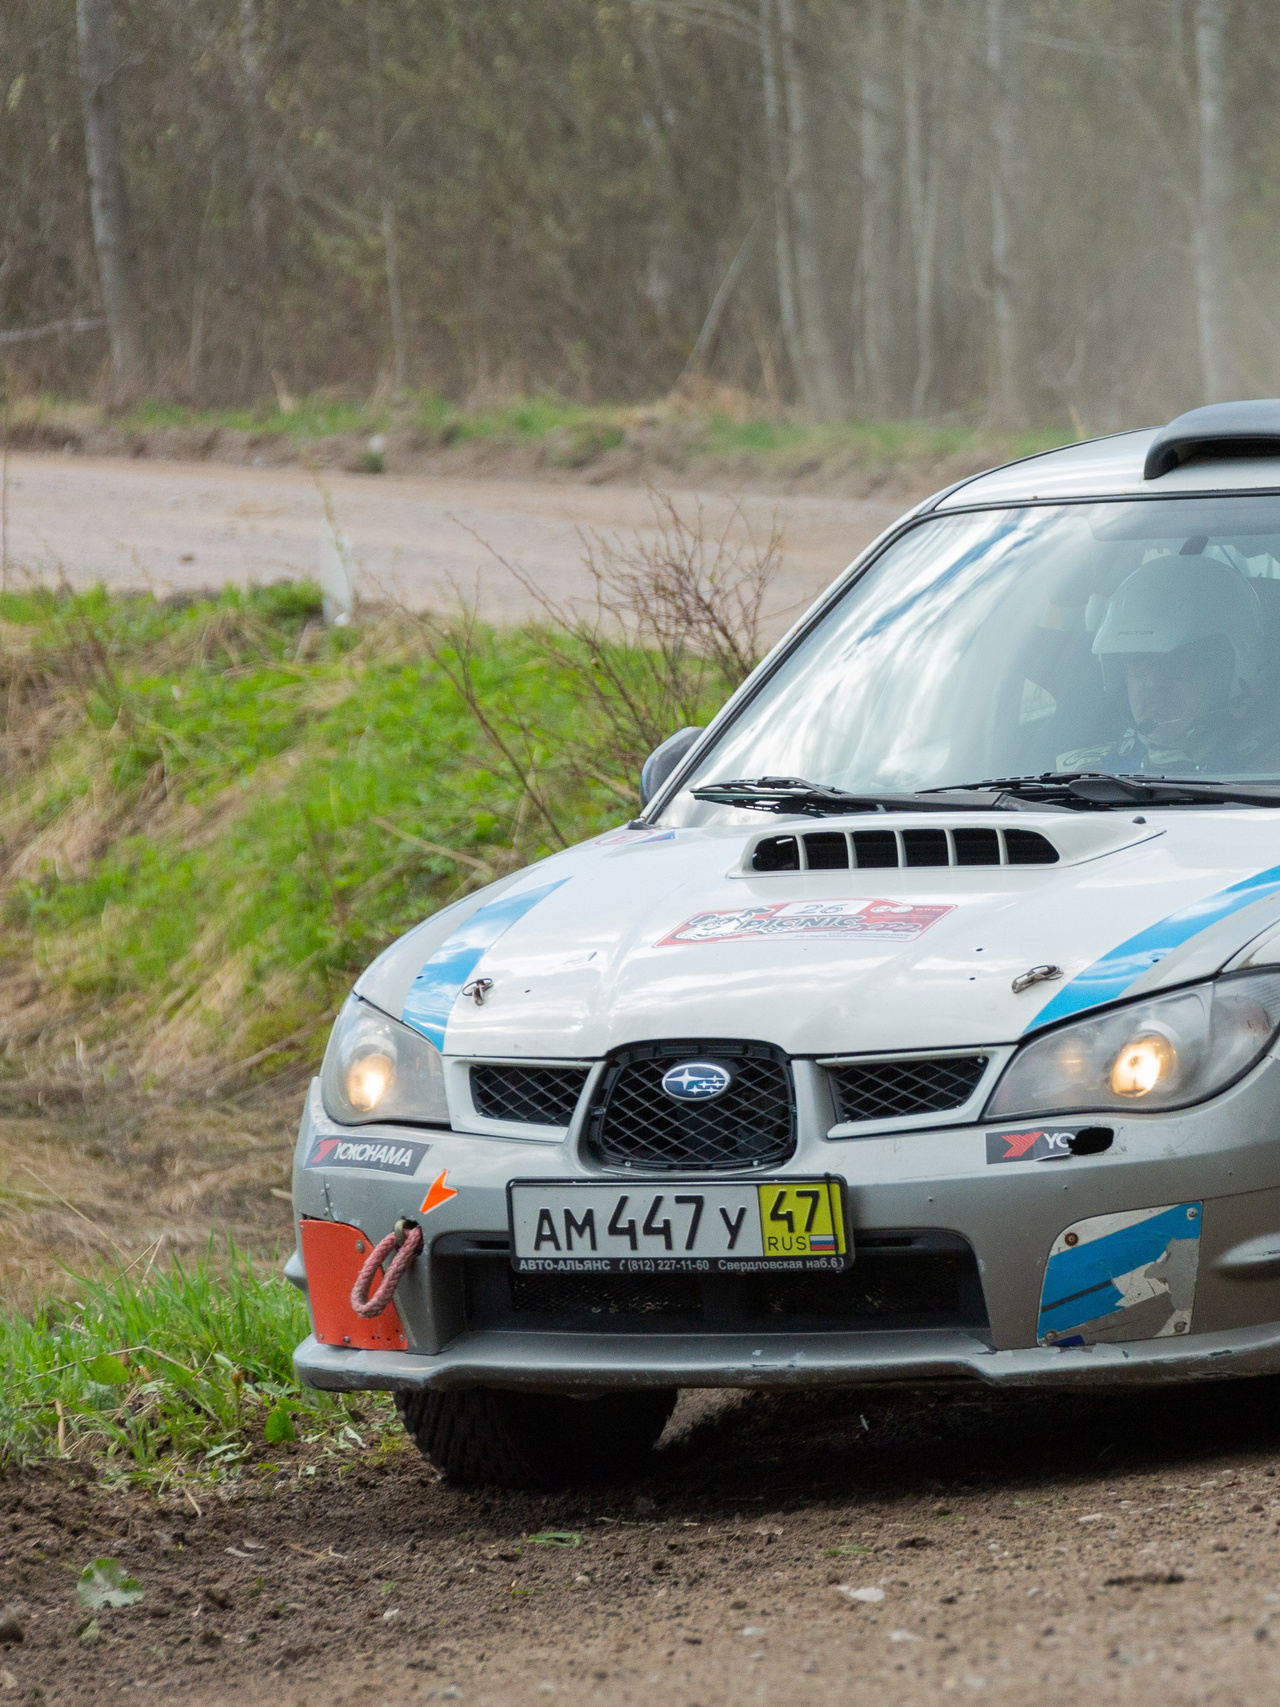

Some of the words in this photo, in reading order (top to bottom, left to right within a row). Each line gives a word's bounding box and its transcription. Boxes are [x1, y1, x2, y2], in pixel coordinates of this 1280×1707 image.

[793, 903, 849, 915] 26
[333, 1142, 413, 1167] YOKOHAMA
[770, 1189, 820, 1233] 47
[768, 1236, 807, 1251] RUS
[519, 1259, 610, 1271] АВТО-АЛЬЯНС
[628, 1259, 655, 1272] (812)
[657, 1259, 709, 1271] 227-11-60
[718, 1259, 802, 1273] Свердловская
